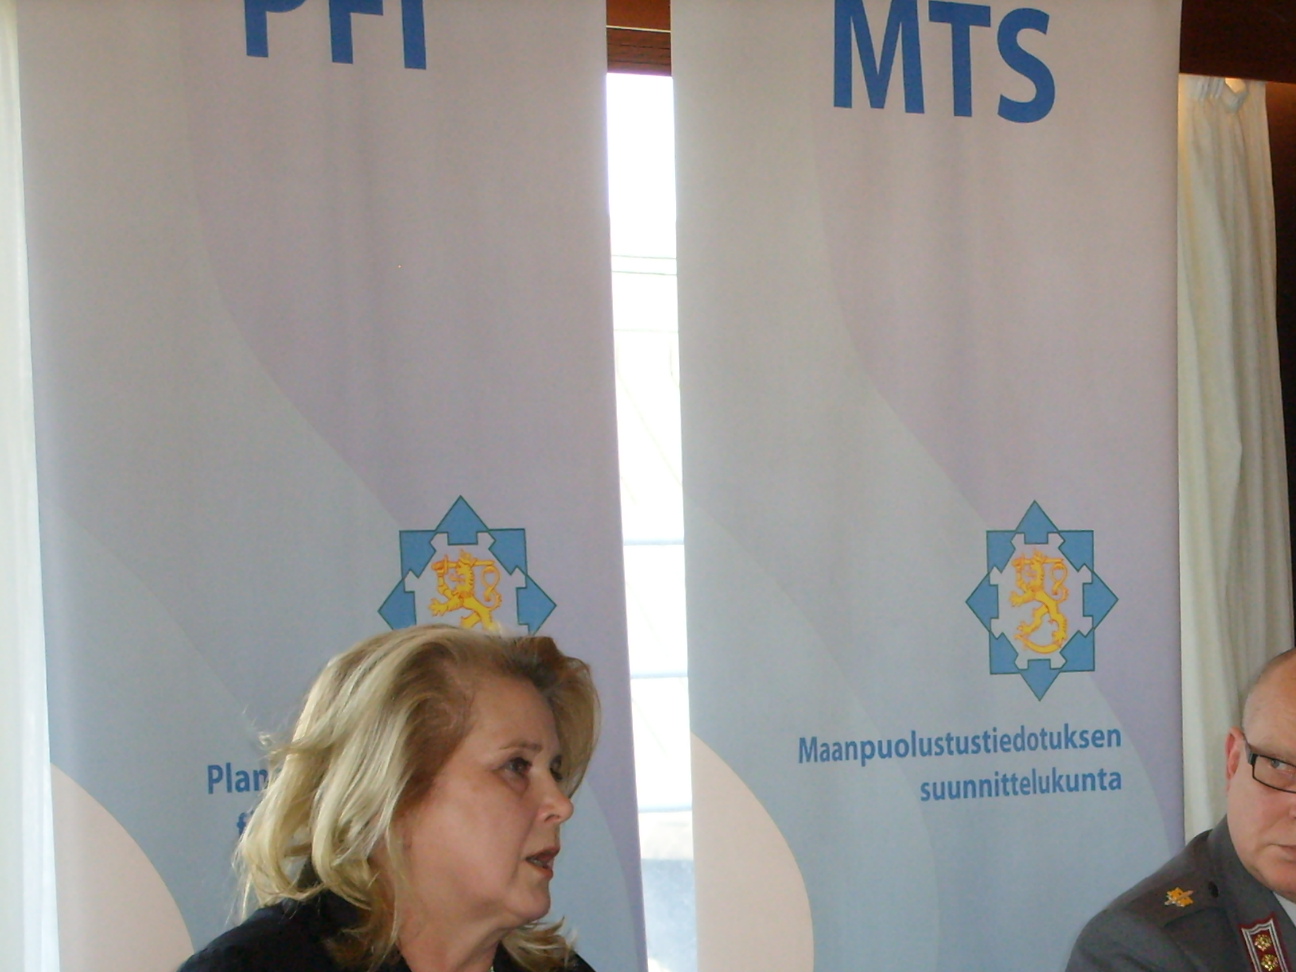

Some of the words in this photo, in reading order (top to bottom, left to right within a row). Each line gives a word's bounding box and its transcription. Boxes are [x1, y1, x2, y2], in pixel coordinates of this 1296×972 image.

[244, 0, 426, 70] PFI
[833, 0, 1055, 124] MTS
[798, 723, 1122, 767] Maanpuolustustiedotuksen
[207, 762, 269, 795] Plan
[920, 767, 1122, 802] suunnittelukunta
